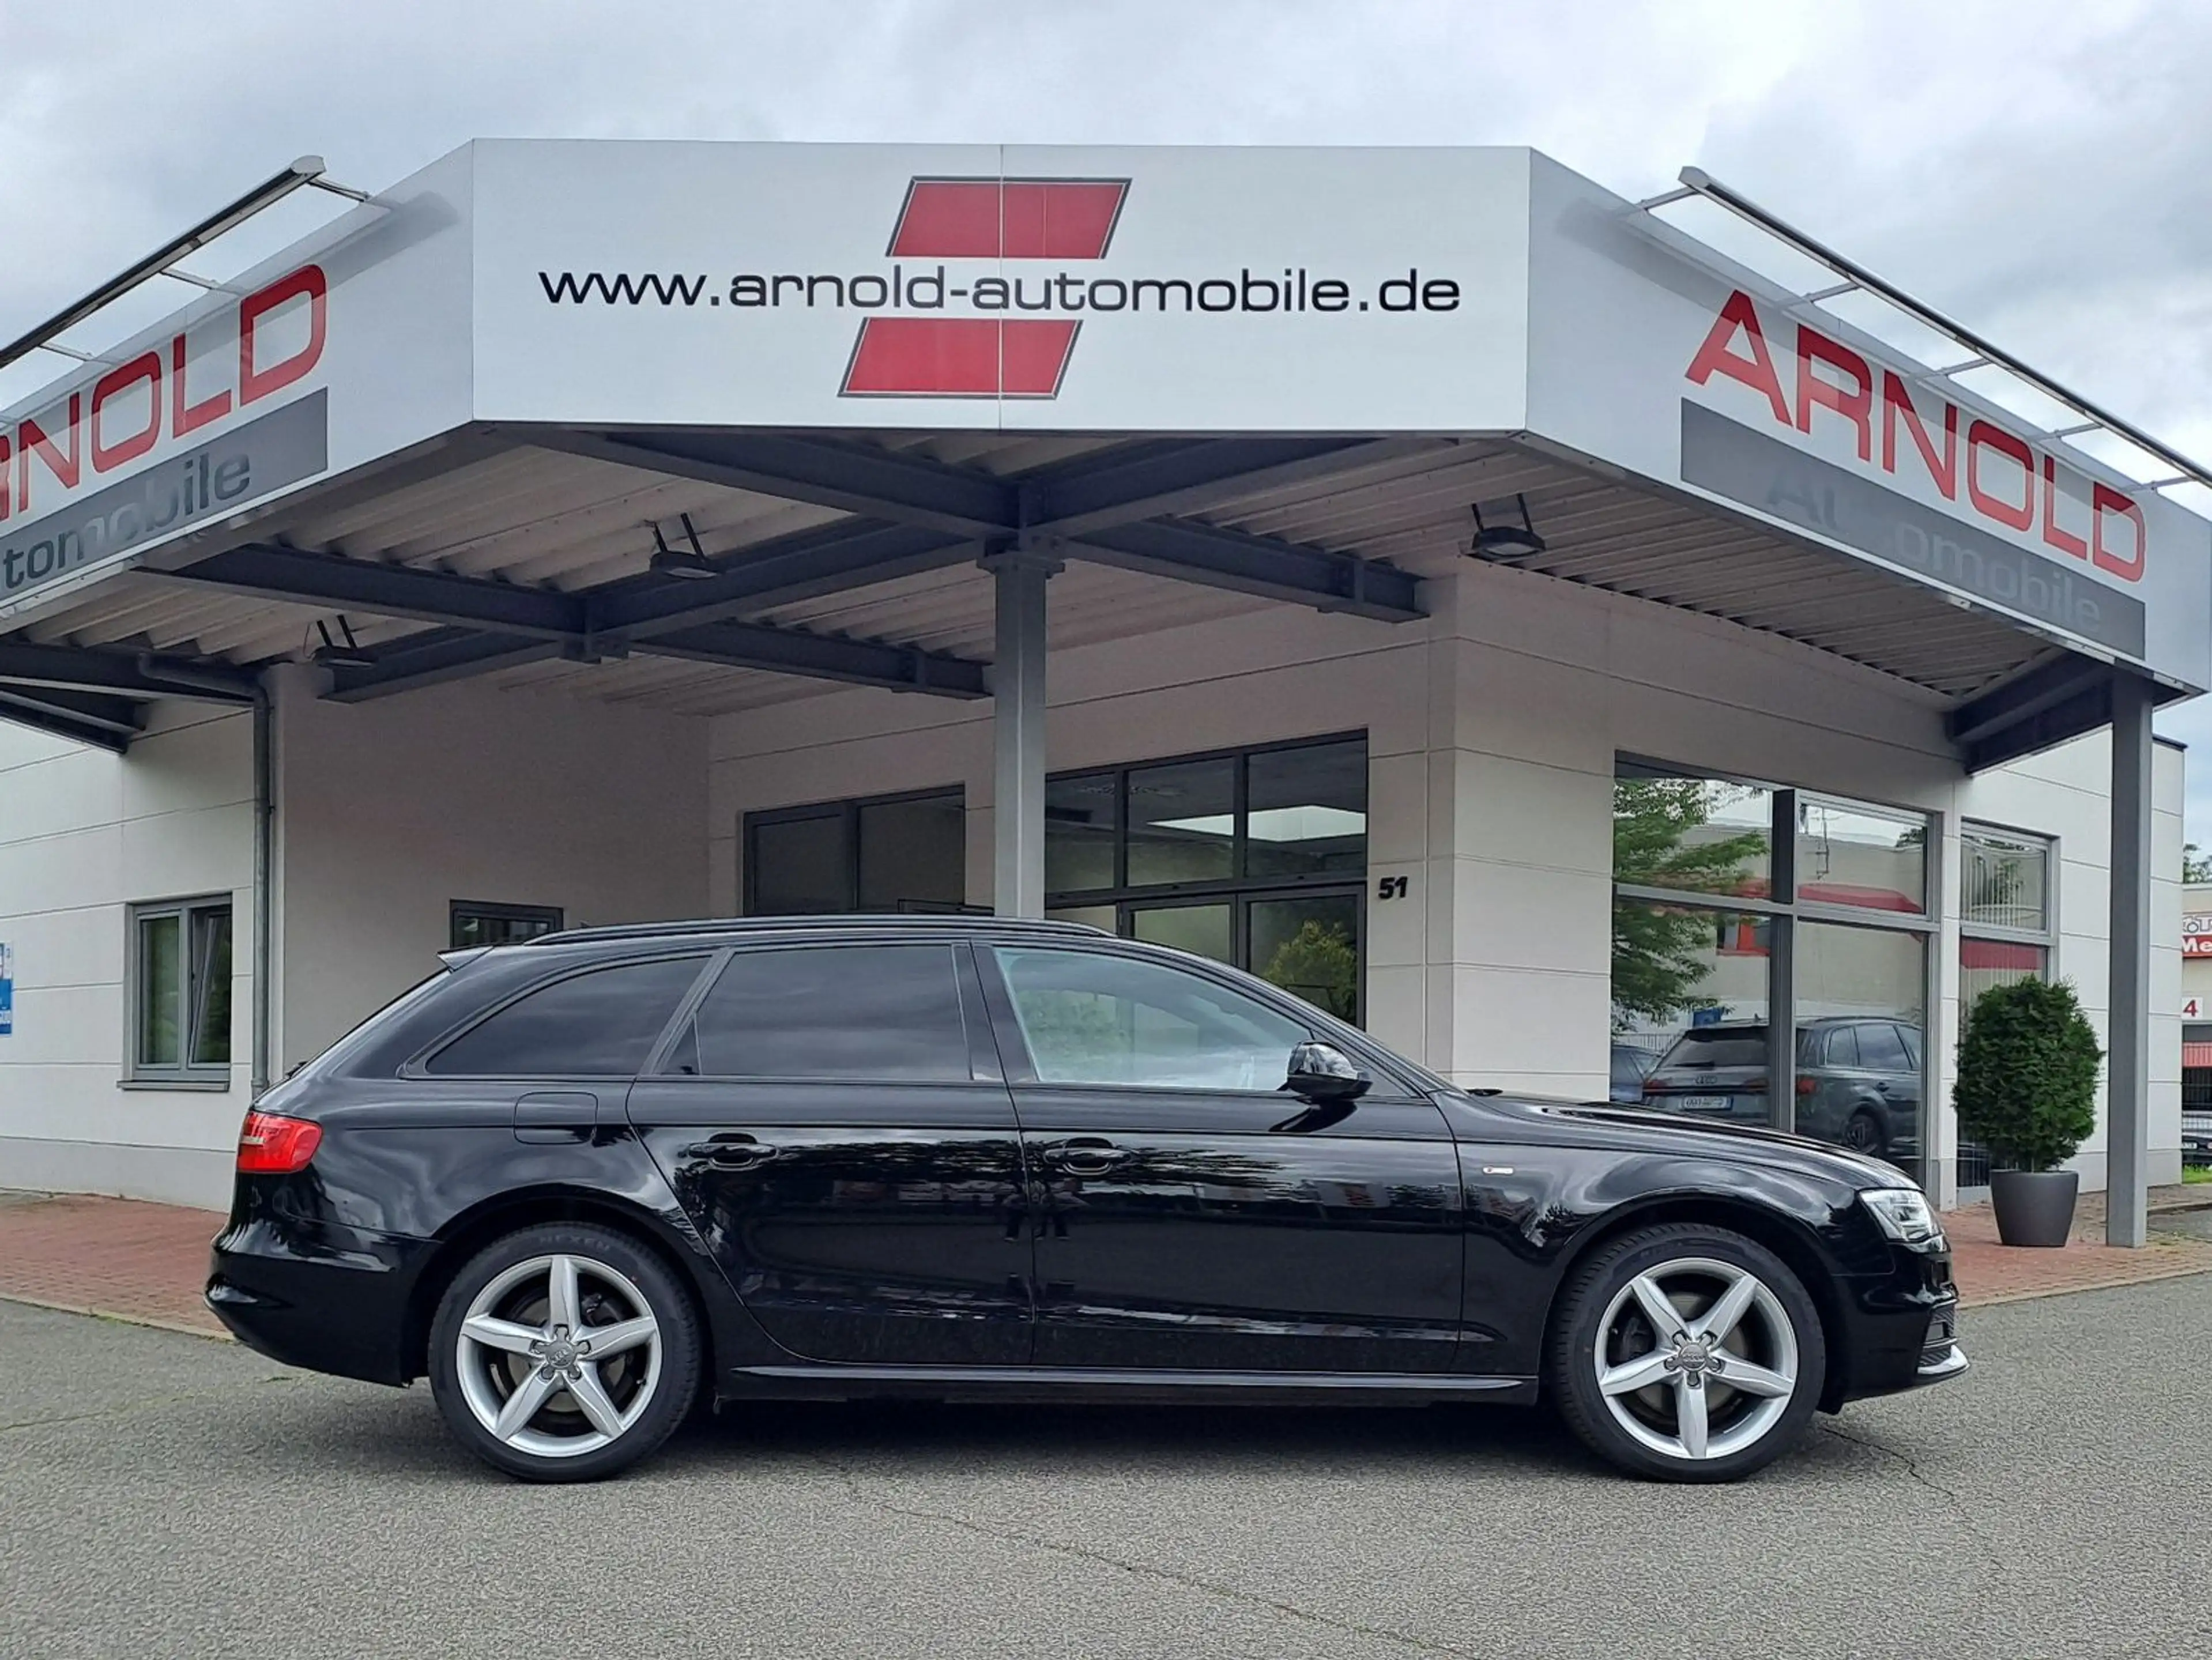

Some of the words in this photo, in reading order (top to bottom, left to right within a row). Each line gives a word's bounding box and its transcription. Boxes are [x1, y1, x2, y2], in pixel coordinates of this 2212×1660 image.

[538, 265, 1459, 312] www.arnold-automobile.de
[1685, 289, 2146, 582] ARNOLD
[1766, 466, 2101, 633] Aomobile
[1378, 876, 1408, 899] 51
[2183, 999, 2198, 1017] 4
